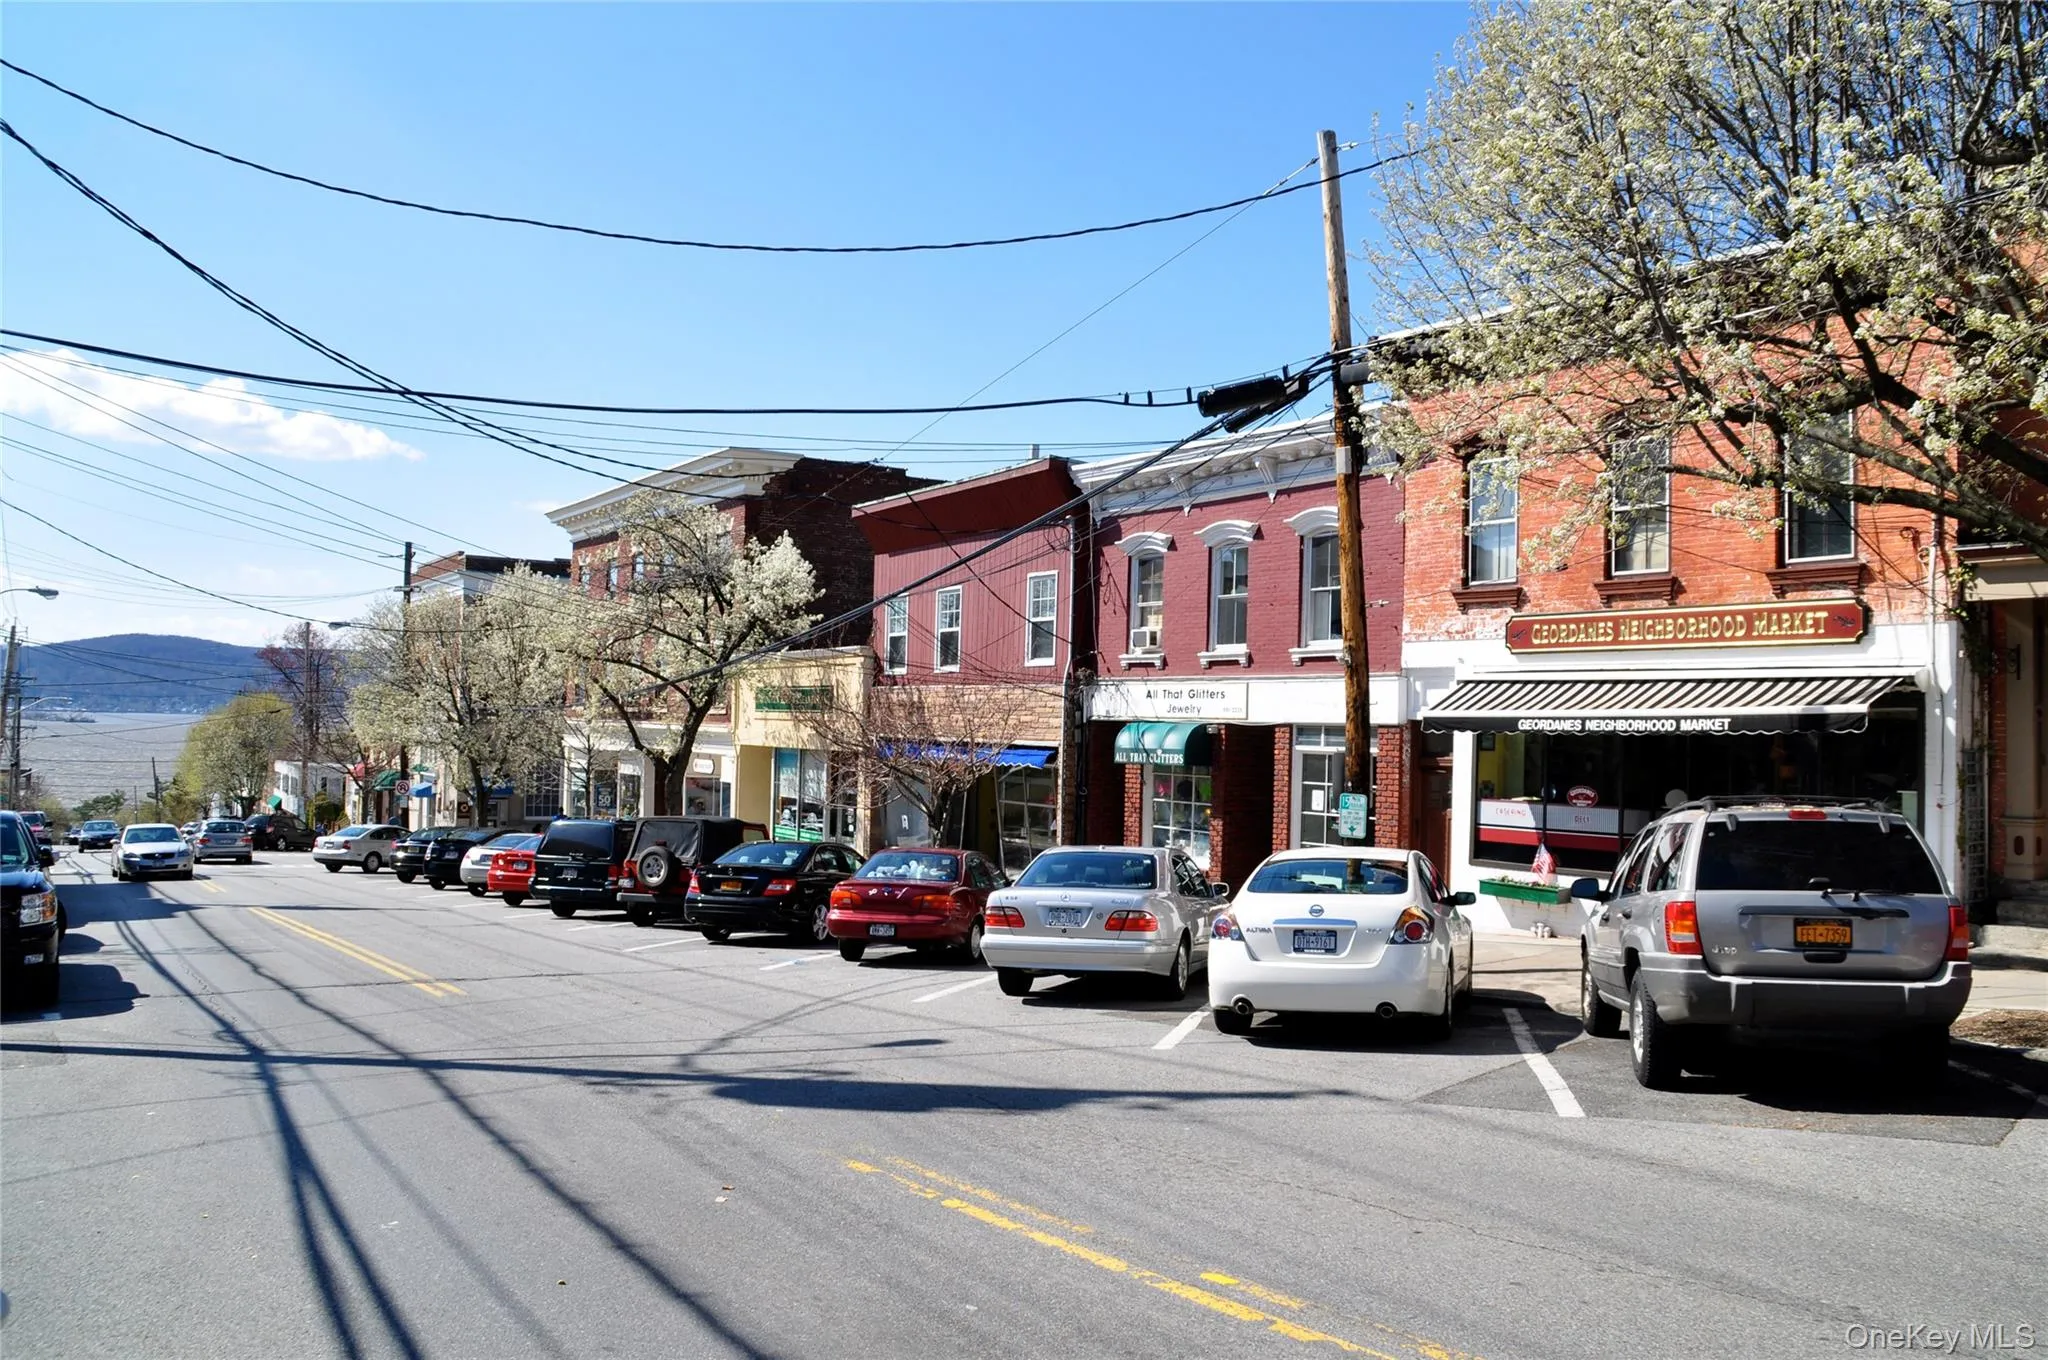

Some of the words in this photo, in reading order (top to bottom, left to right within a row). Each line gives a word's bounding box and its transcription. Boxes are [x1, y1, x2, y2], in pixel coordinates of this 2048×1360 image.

[1531, 620, 1615, 645] GEORDANES
[1618, 615, 1747, 641] NEIGHBORHOOD
[1752, 611, 1829, 637] MARKET
[1146, 689, 1158, 699] All
[1163, 689, 1183, 699] That
[1188, 689, 1226, 699] Glitters
[1167, 703, 1202, 715] Jewelry
[1518, 718, 1582, 731] GEORDANES
[1585, 718, 1676, 731] NEIGHBORHOOD
[1679, 718, 1732, 731] MARKET
[1114, 752, 1128, 763] ALL
[1130, 752, 1147, 763] THAT
